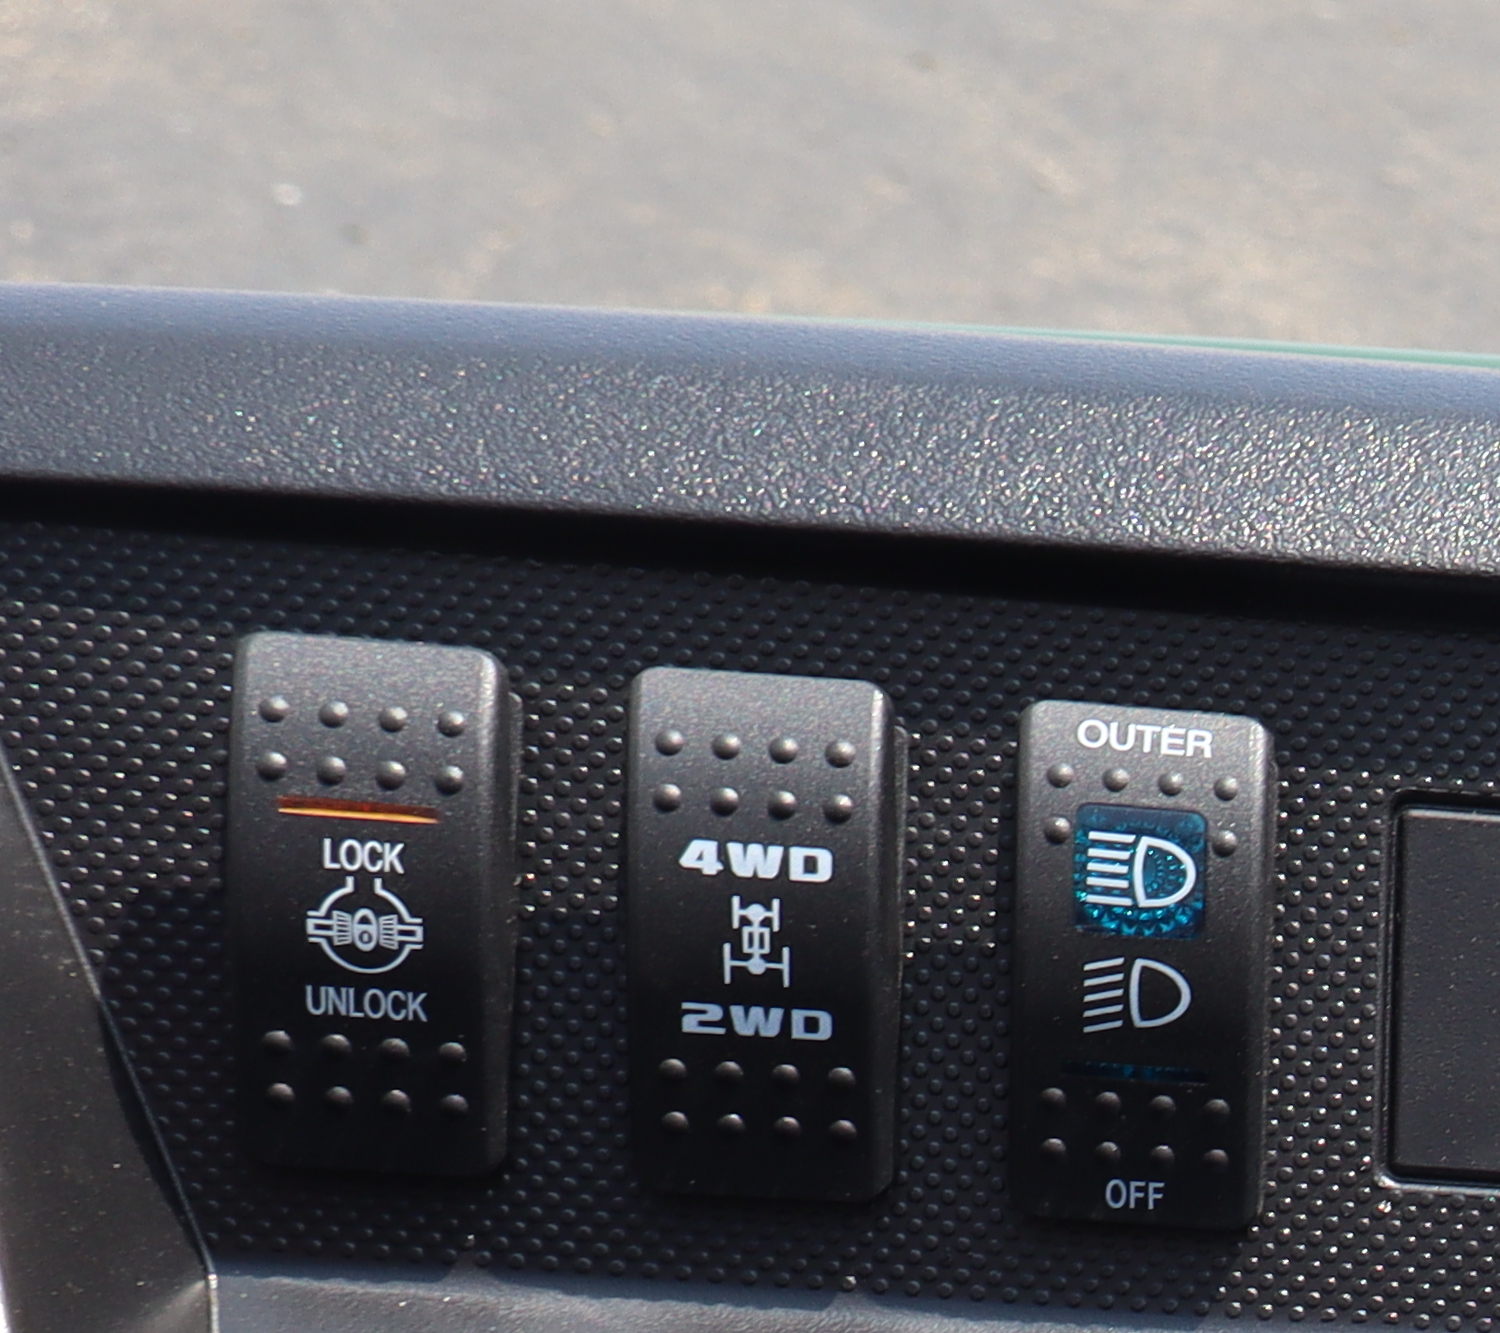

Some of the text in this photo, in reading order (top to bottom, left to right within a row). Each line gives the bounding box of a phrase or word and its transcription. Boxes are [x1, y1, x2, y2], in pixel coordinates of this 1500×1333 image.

[1076, 718, 1215, 760] OUTER
[323, 838, 405, 875] LOCK
[678, 839, 834, 884] 4WD
[305, 986, 428, 1023] UNLOCK
[679, 1001, 834, 1043] 2WD
[1104, 1179, 1164, 1212] OFF
